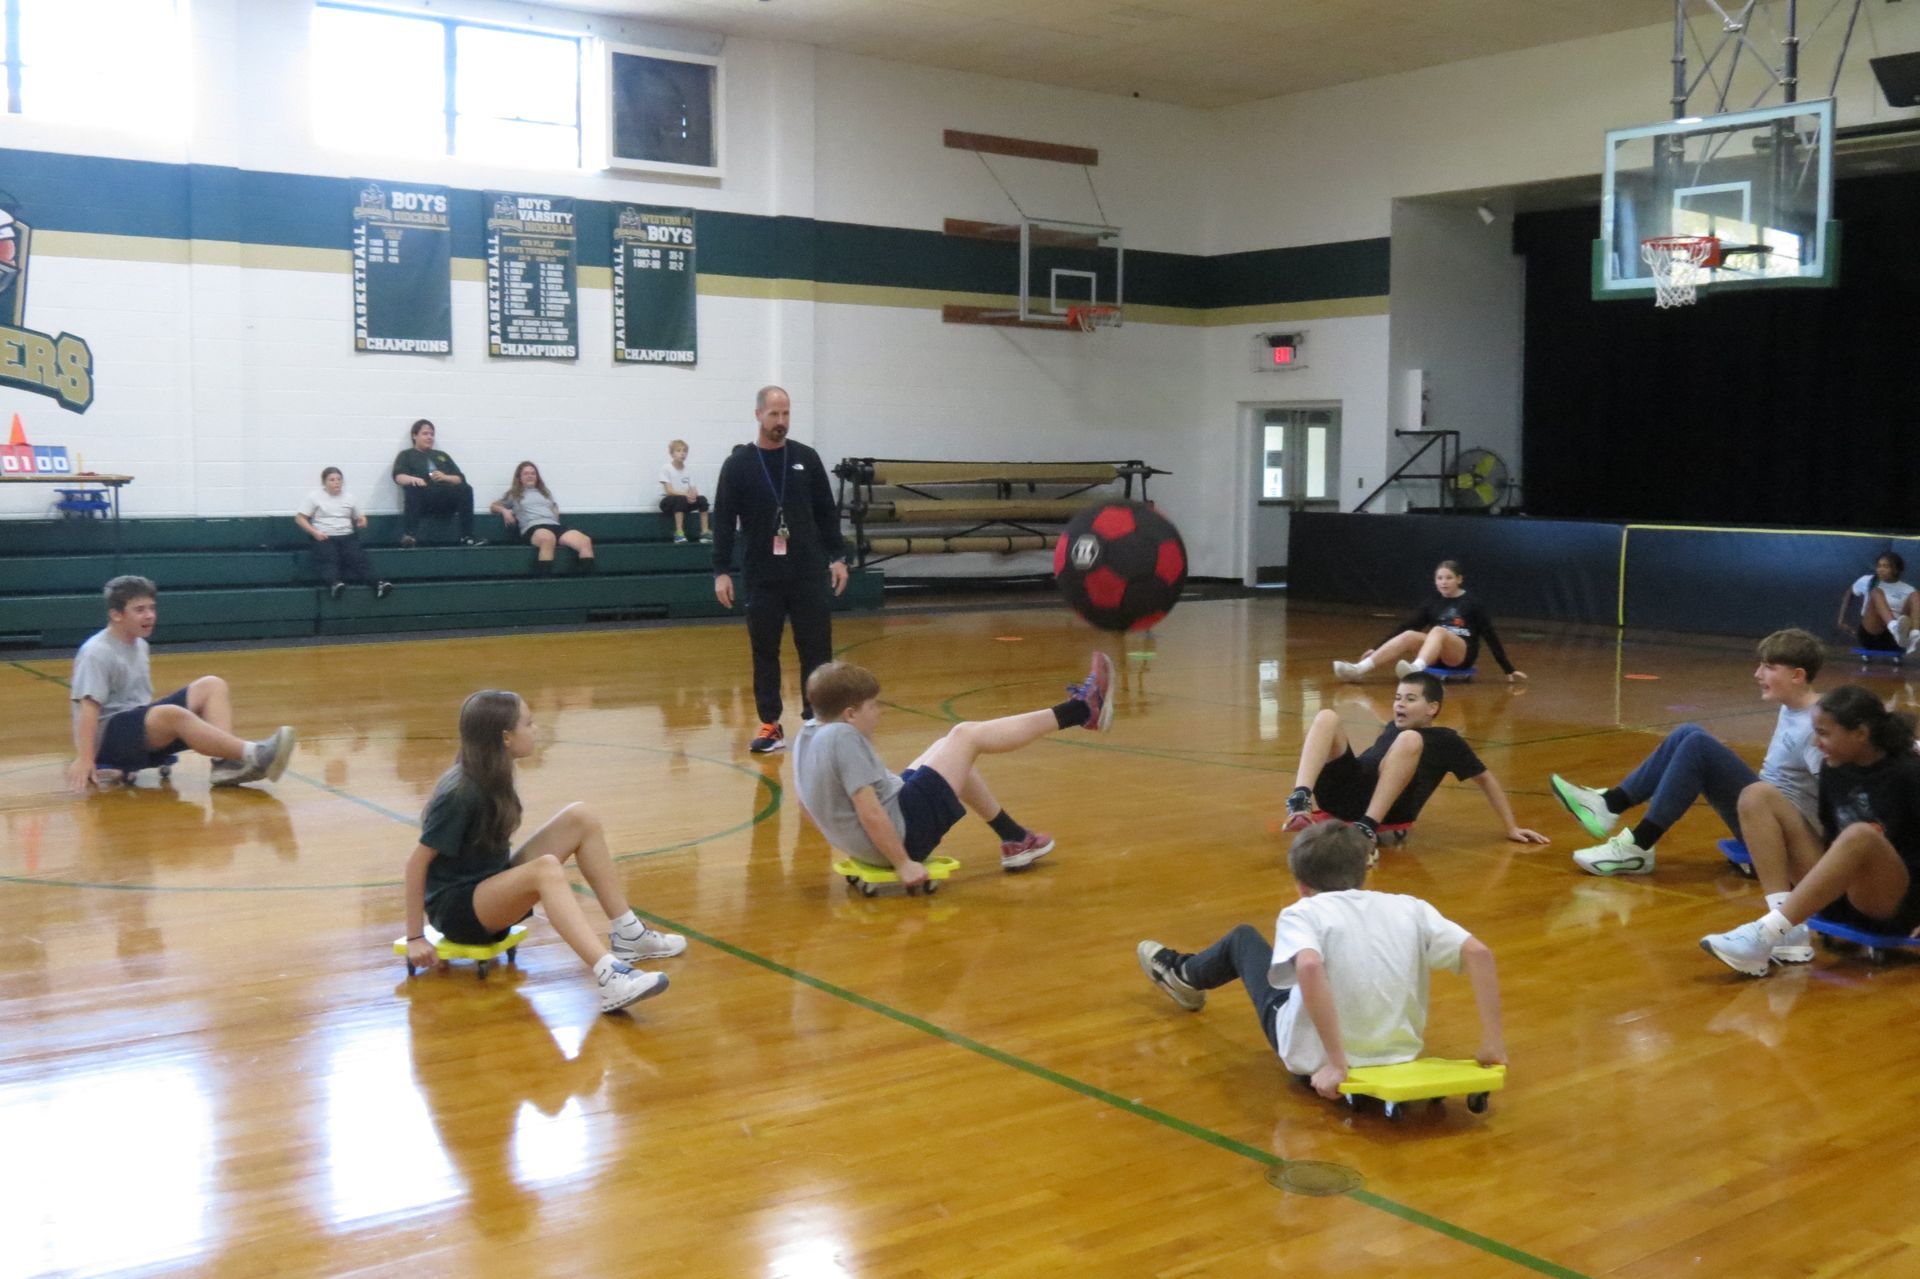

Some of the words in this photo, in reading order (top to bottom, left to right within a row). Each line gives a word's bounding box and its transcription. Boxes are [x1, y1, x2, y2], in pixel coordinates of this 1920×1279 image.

[391, 191, 448, 213] BOYS
[517, 197, 551, 210] BOYS
[394, 210, 447, 225] DIOCESAN
[519, 209, 573, 224] VARSITY
[647, 225, 693, 244] BOYS
[353, 225, 368, 338] BASKETBALL
[488, 235, 501, 344] BASKETBALL
[613, 244, 626, 350] BASKETBALL
[366, 338, 449, 353] CHAMPIONS
[500, 343, 576, 357] CHAMPIONS
[624, 349, 695, 363] CHAMPIONS
